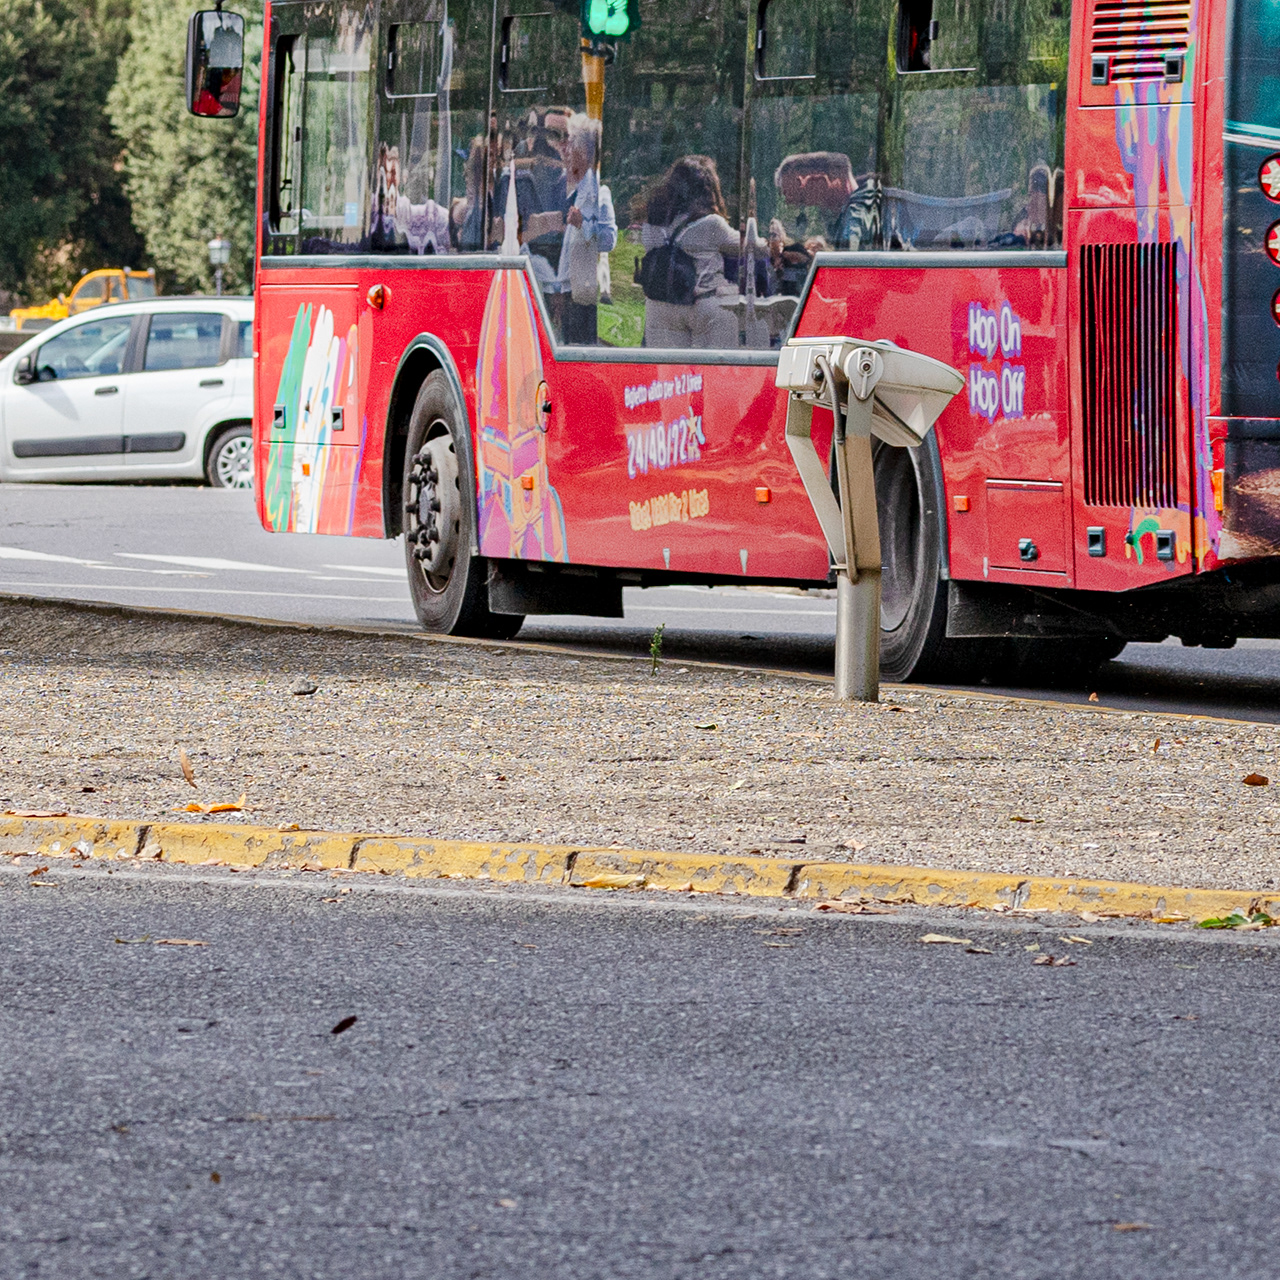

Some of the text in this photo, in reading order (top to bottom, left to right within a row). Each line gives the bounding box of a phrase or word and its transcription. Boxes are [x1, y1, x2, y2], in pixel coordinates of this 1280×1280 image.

[968, 302, 1021, 361] Hop On
[969, 364, 1025, 422] Hop Off
[628, 417, 687, 477] 24/48/72
